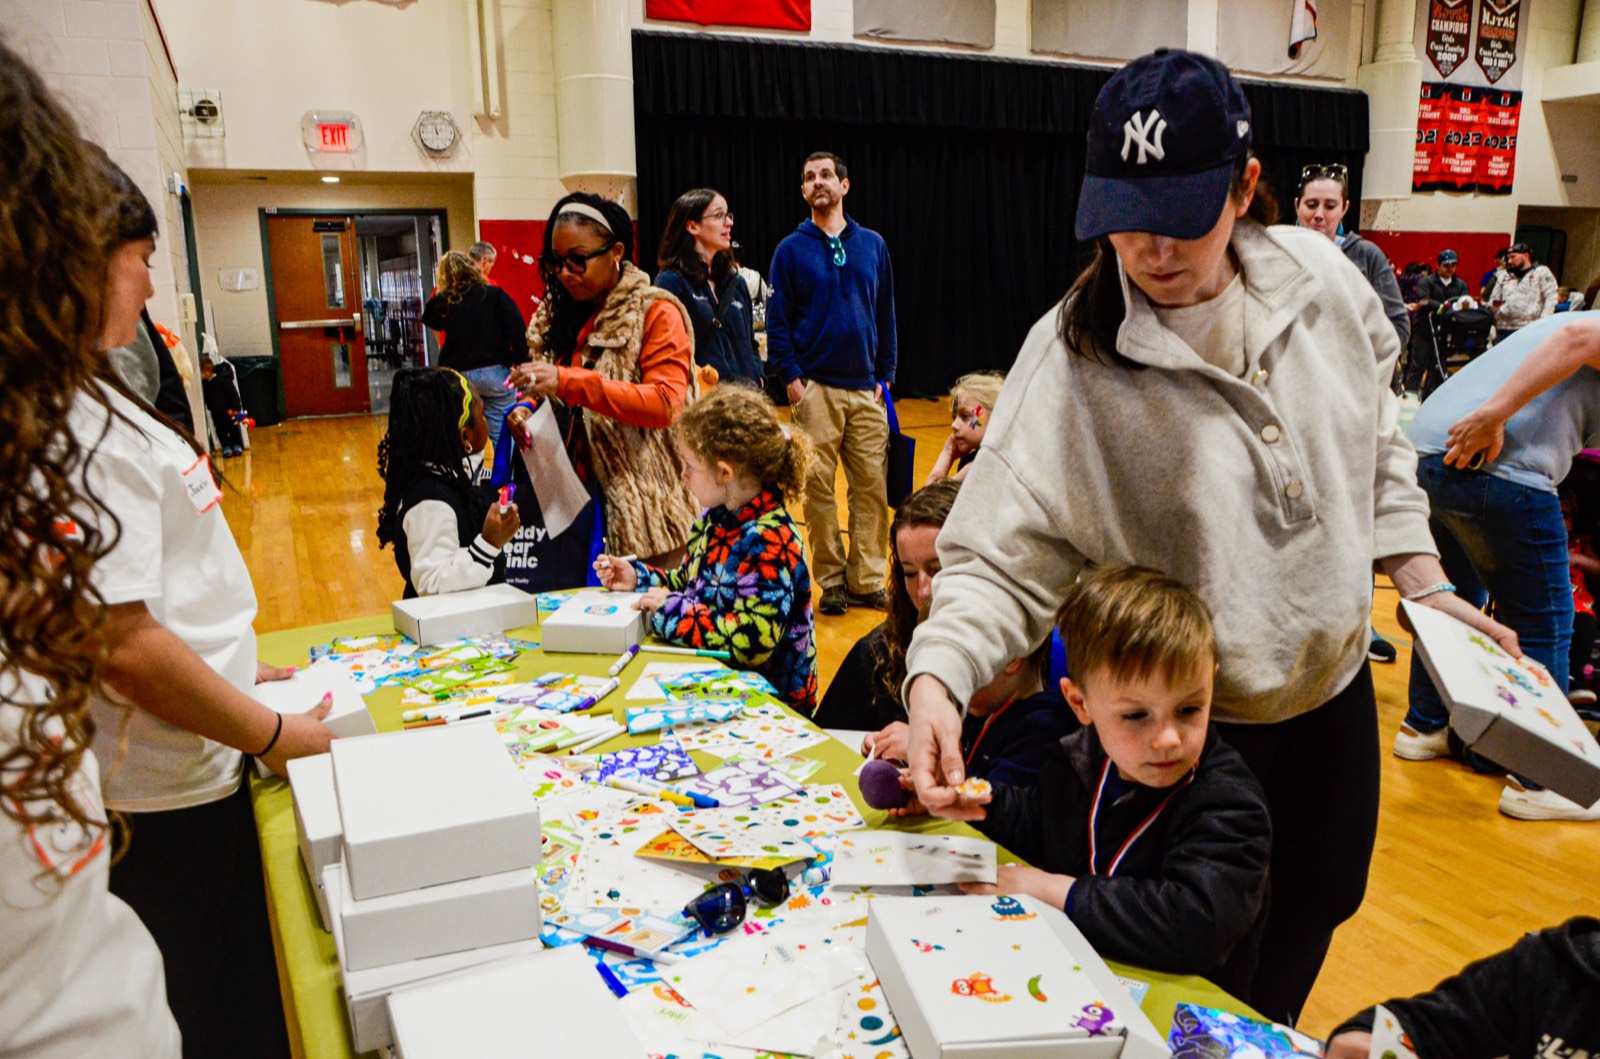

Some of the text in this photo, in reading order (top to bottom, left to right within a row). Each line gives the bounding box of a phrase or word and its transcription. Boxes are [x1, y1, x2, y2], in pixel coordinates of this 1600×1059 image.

[1482, 6, 1516, 29] NJTAC
[1431, 19, 1468, 35] CHAMPIONS
[321, 126, 347, 146] EXIT
[1121, 109, 1168, 165] NY
[1445, 130, 1482, 147] 2023
[514, 525, 547, 542] ddy
[503, 542, 534, 554] ear
[505, 553, 538, 569] inic
